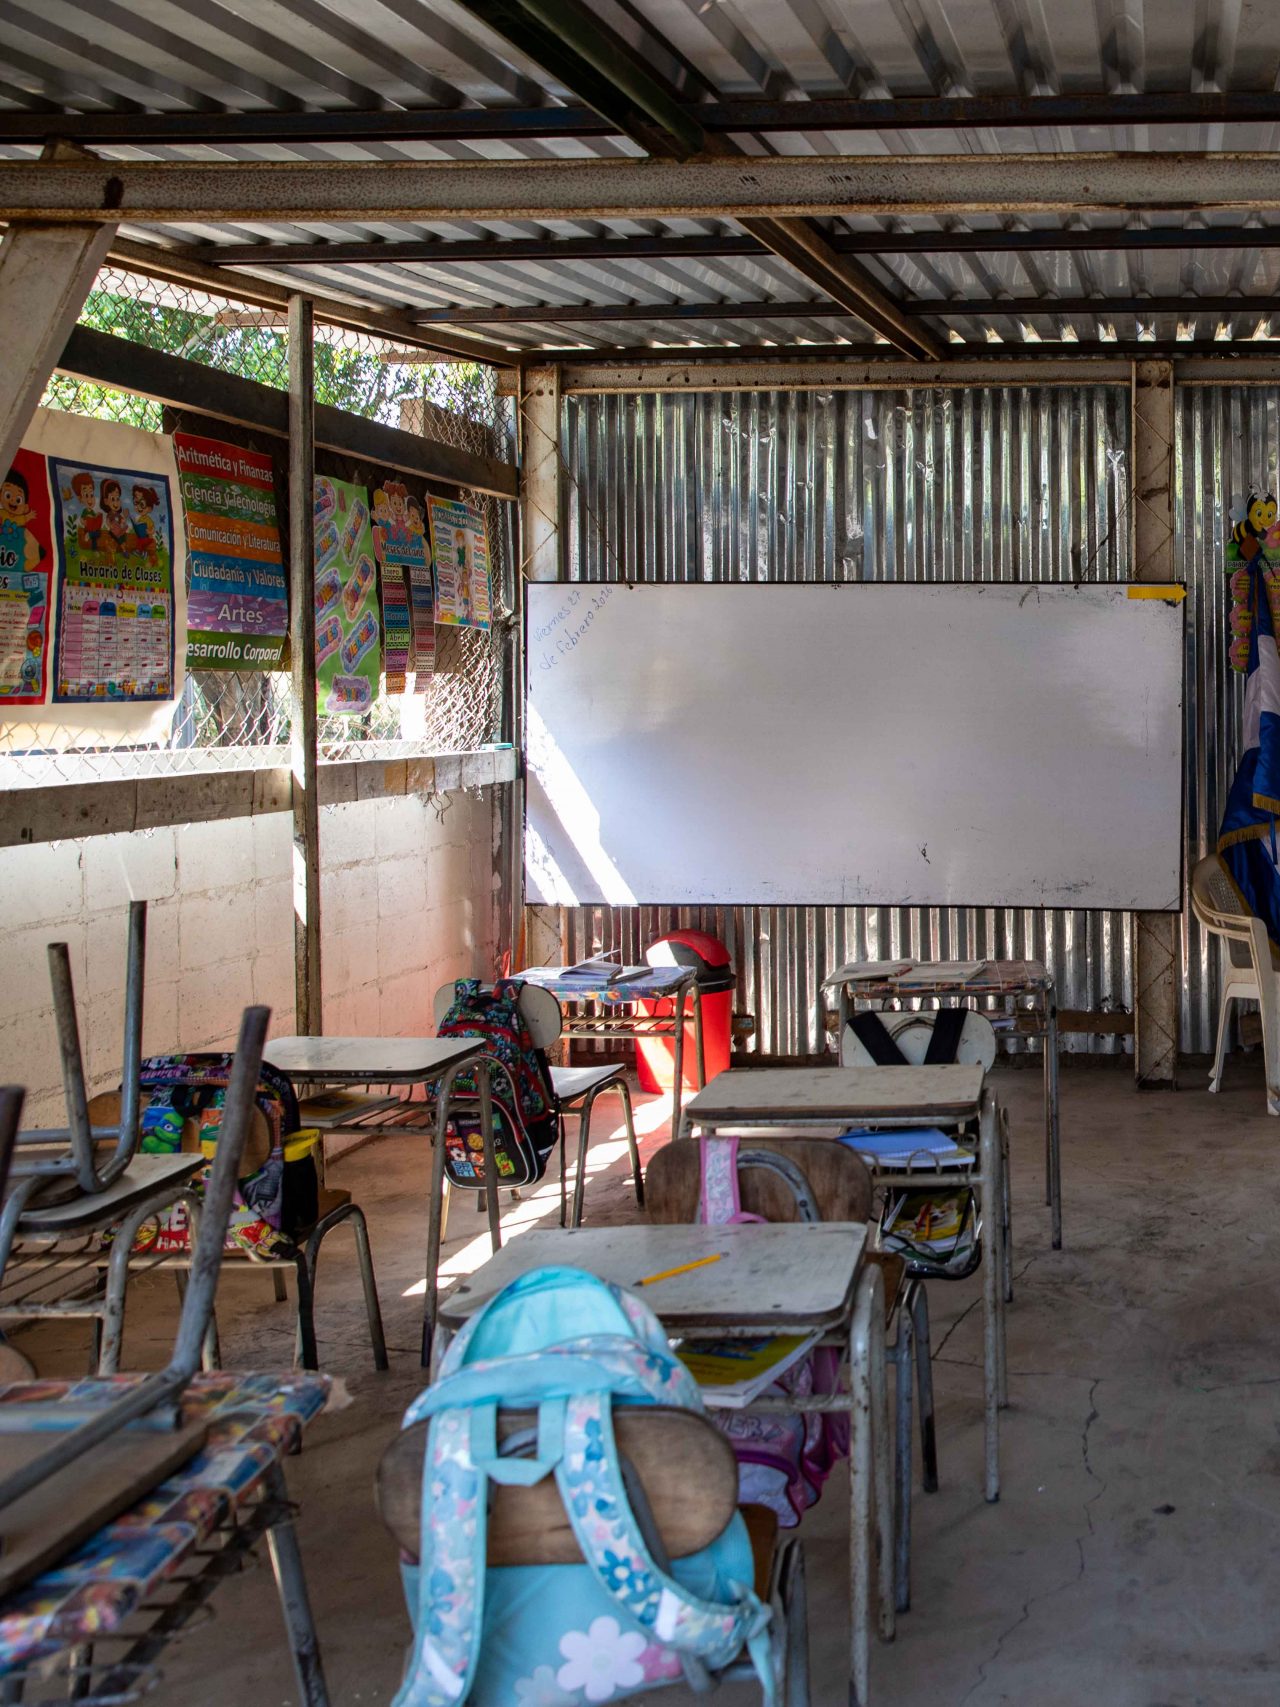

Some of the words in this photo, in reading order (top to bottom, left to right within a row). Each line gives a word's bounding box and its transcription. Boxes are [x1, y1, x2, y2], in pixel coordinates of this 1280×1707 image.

[178, 446, 232, 472] Aritmética
[232, 463, 238, 475] y
[240, 460, 274, 484] Finanzas
[184, 482, 222, 505] Ciencia
[230, 492, 277, 519] Tecnología
[190, 521, 241, 547] Comunicación
[248, 533, 281, 553] Literatura
[80, 560, 119, 579] Horario
[122, 566, 133, 580] de
[135, 566, 163, 583] Clases
[193, 560, 244, 583] Ciudadanía
[246, 573, 252, 588] y
[252, 569, 286, 589] Valores
[218, 604, 264, 625] Artes
[390, 633, 405, 641] Abril
[187, 640, 241, 661] esarrollo
[243, 643, 283, 665] Corporal
[540, 652, 559, 670] de
